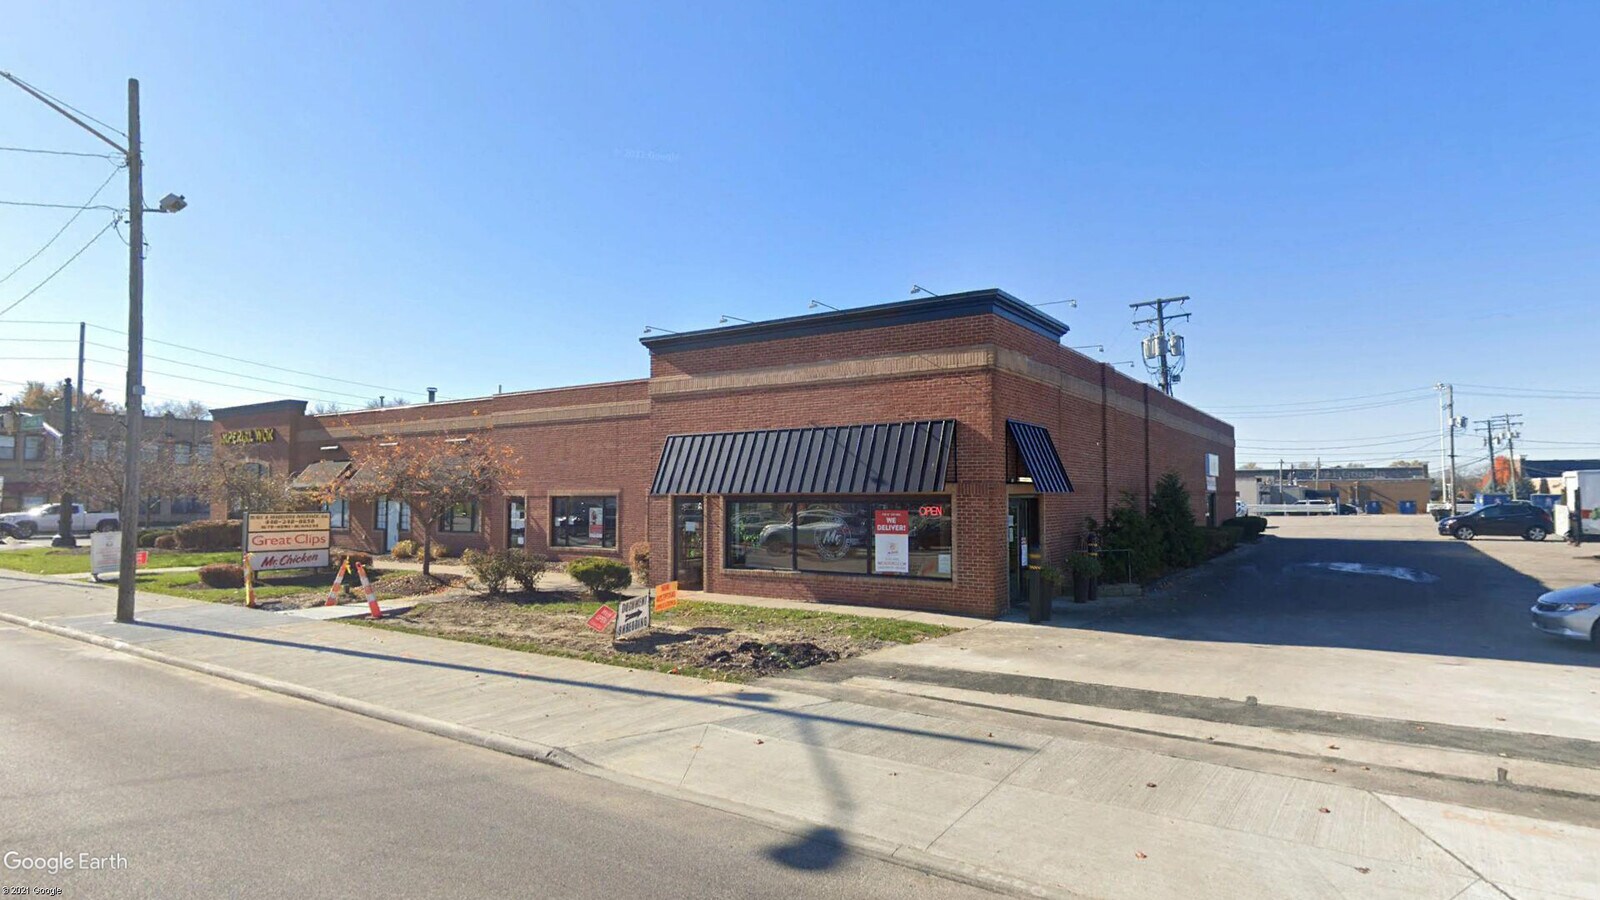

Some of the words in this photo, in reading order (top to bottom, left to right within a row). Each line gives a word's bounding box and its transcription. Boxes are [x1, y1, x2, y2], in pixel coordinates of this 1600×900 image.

[919, 506, 943, 517] OPEN
[876, 524, 906, 532] DELIVER!
[251, 534, 292, 546] Great
[294, 533, 327, 546] Clips
[260, 556, 278, 567] Mr.
[279, 552, 319, 566] Chicken
[621, 596, 647, 613] DOCUMENT
[617, 616, 647, 635] SHREDDING
